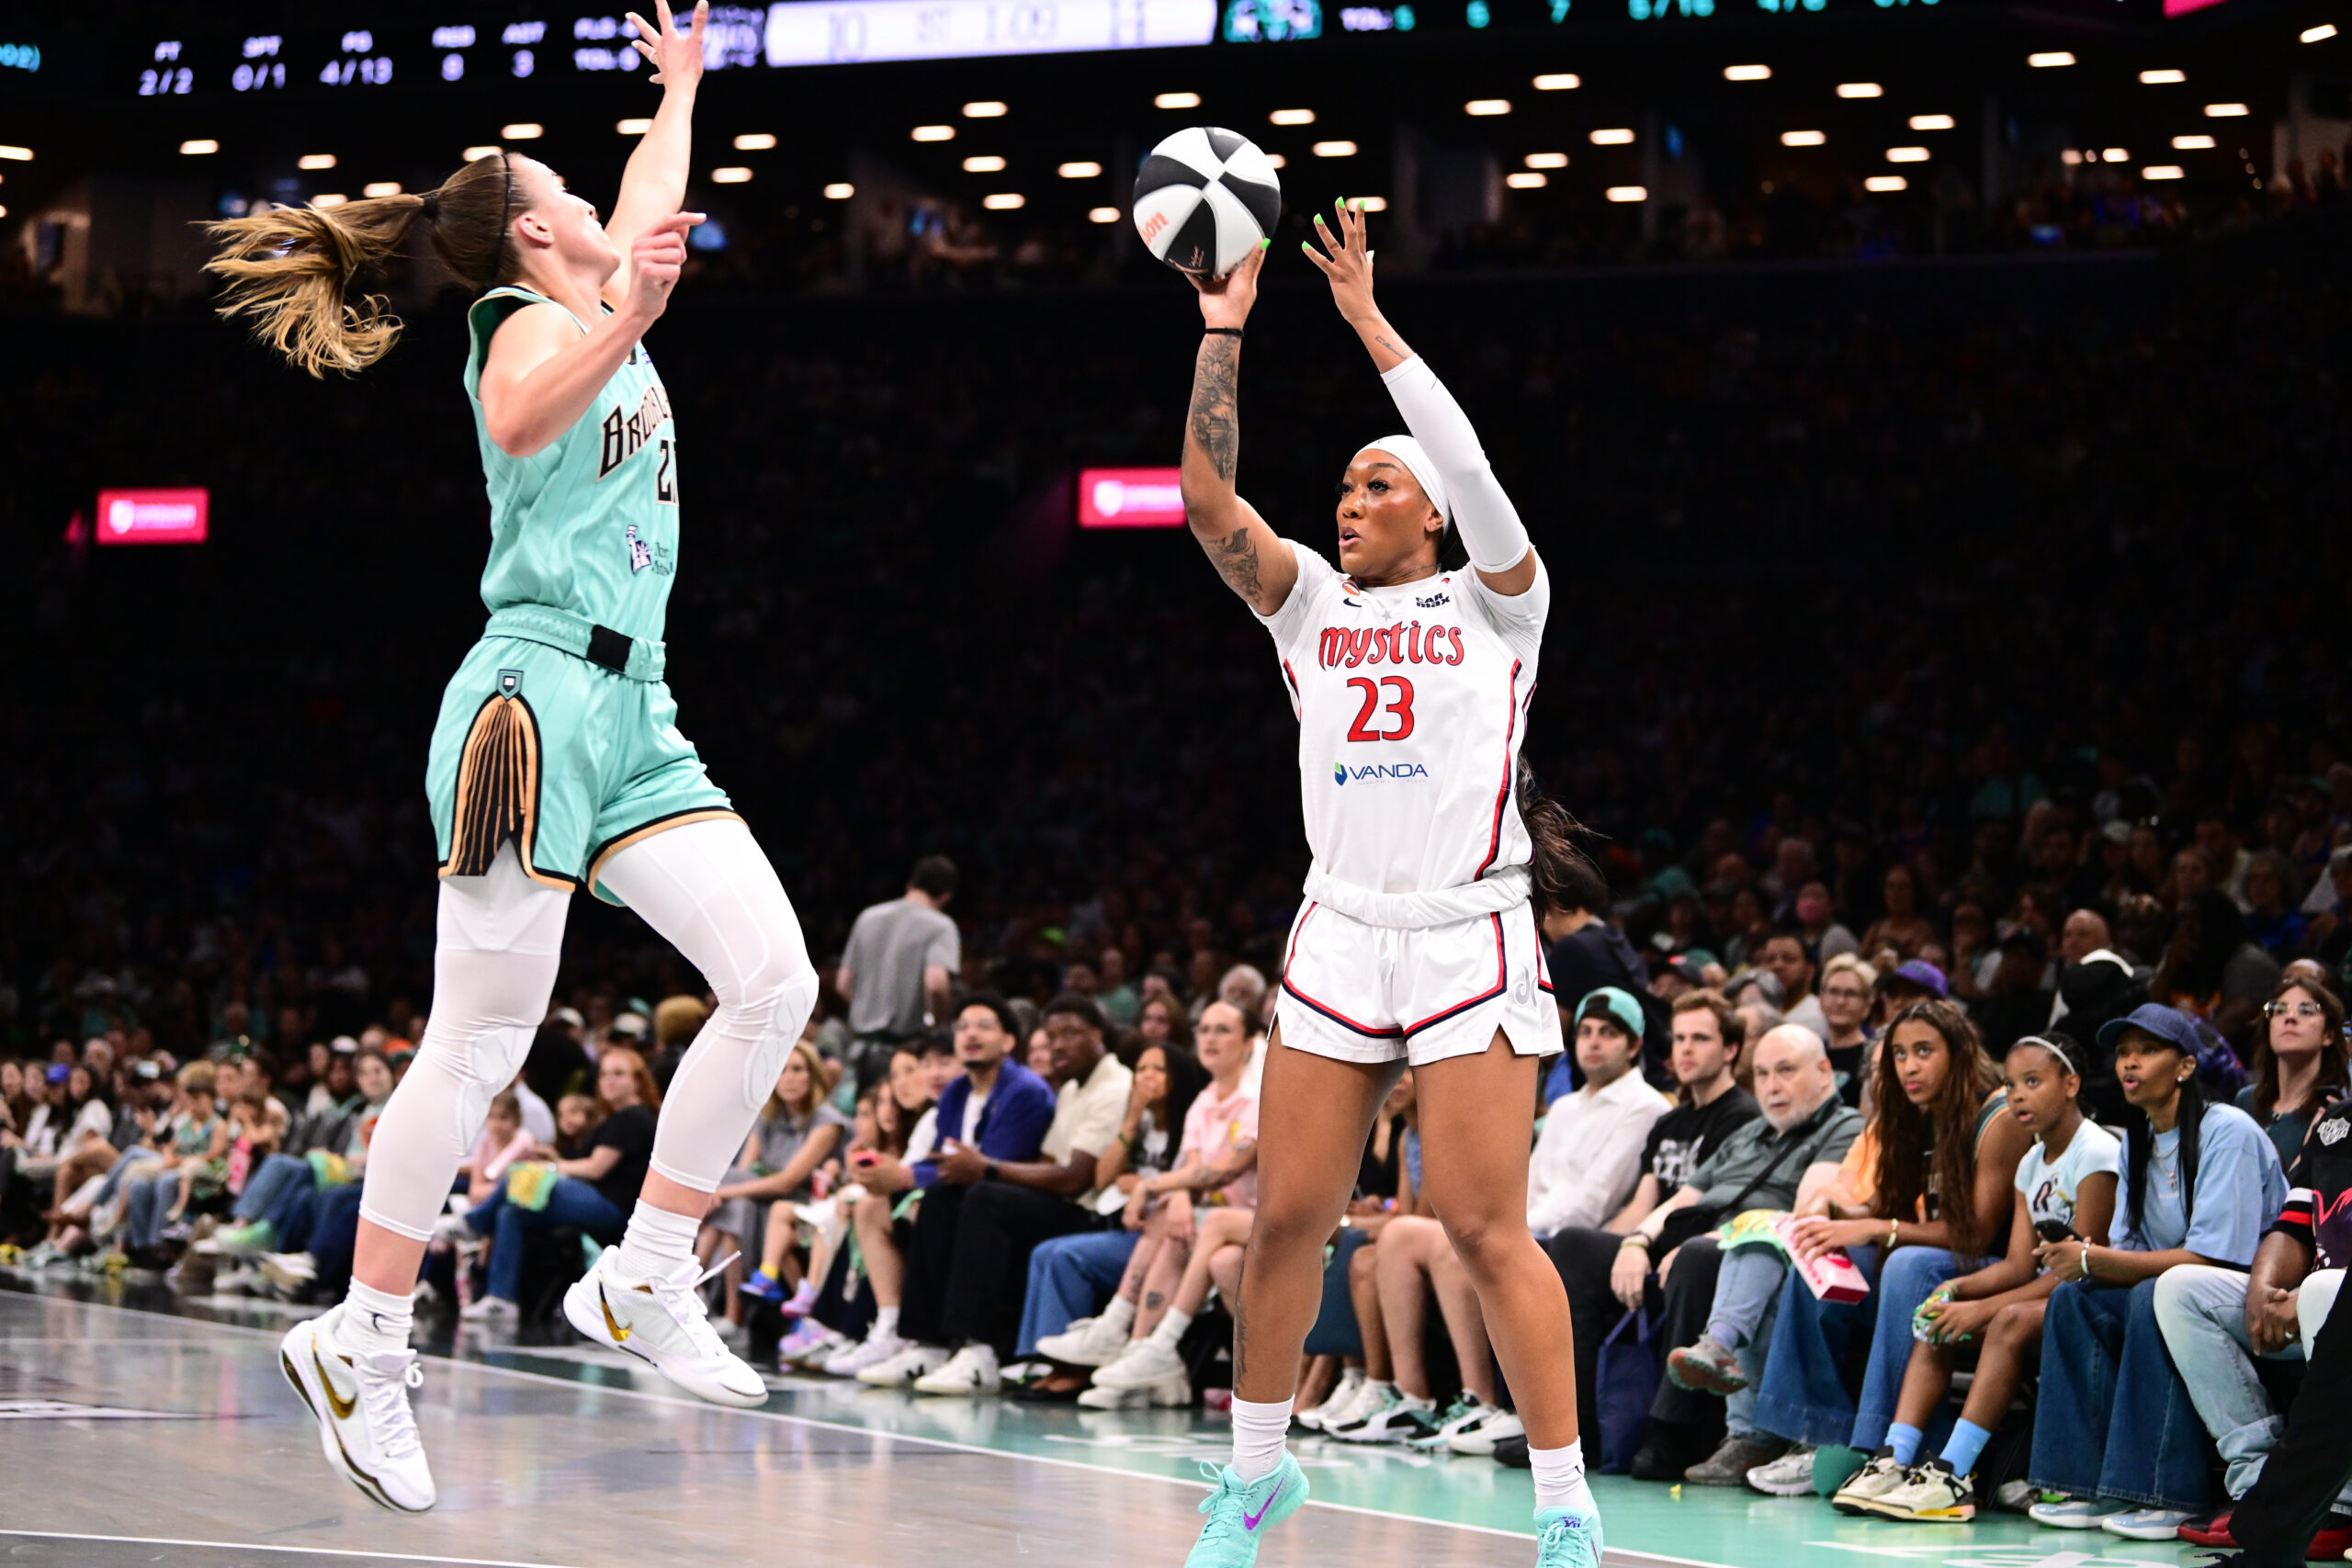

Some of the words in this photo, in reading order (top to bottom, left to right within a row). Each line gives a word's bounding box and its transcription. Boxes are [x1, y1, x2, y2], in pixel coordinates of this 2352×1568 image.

[139, 67, 193, 96] 2/2
[232, 62, 286, 91] 0/1
[655, 437, 680, 506] 2
[1347, 676, 1415, 742] 23
[1349, 764, 1429, 780] VANDA
